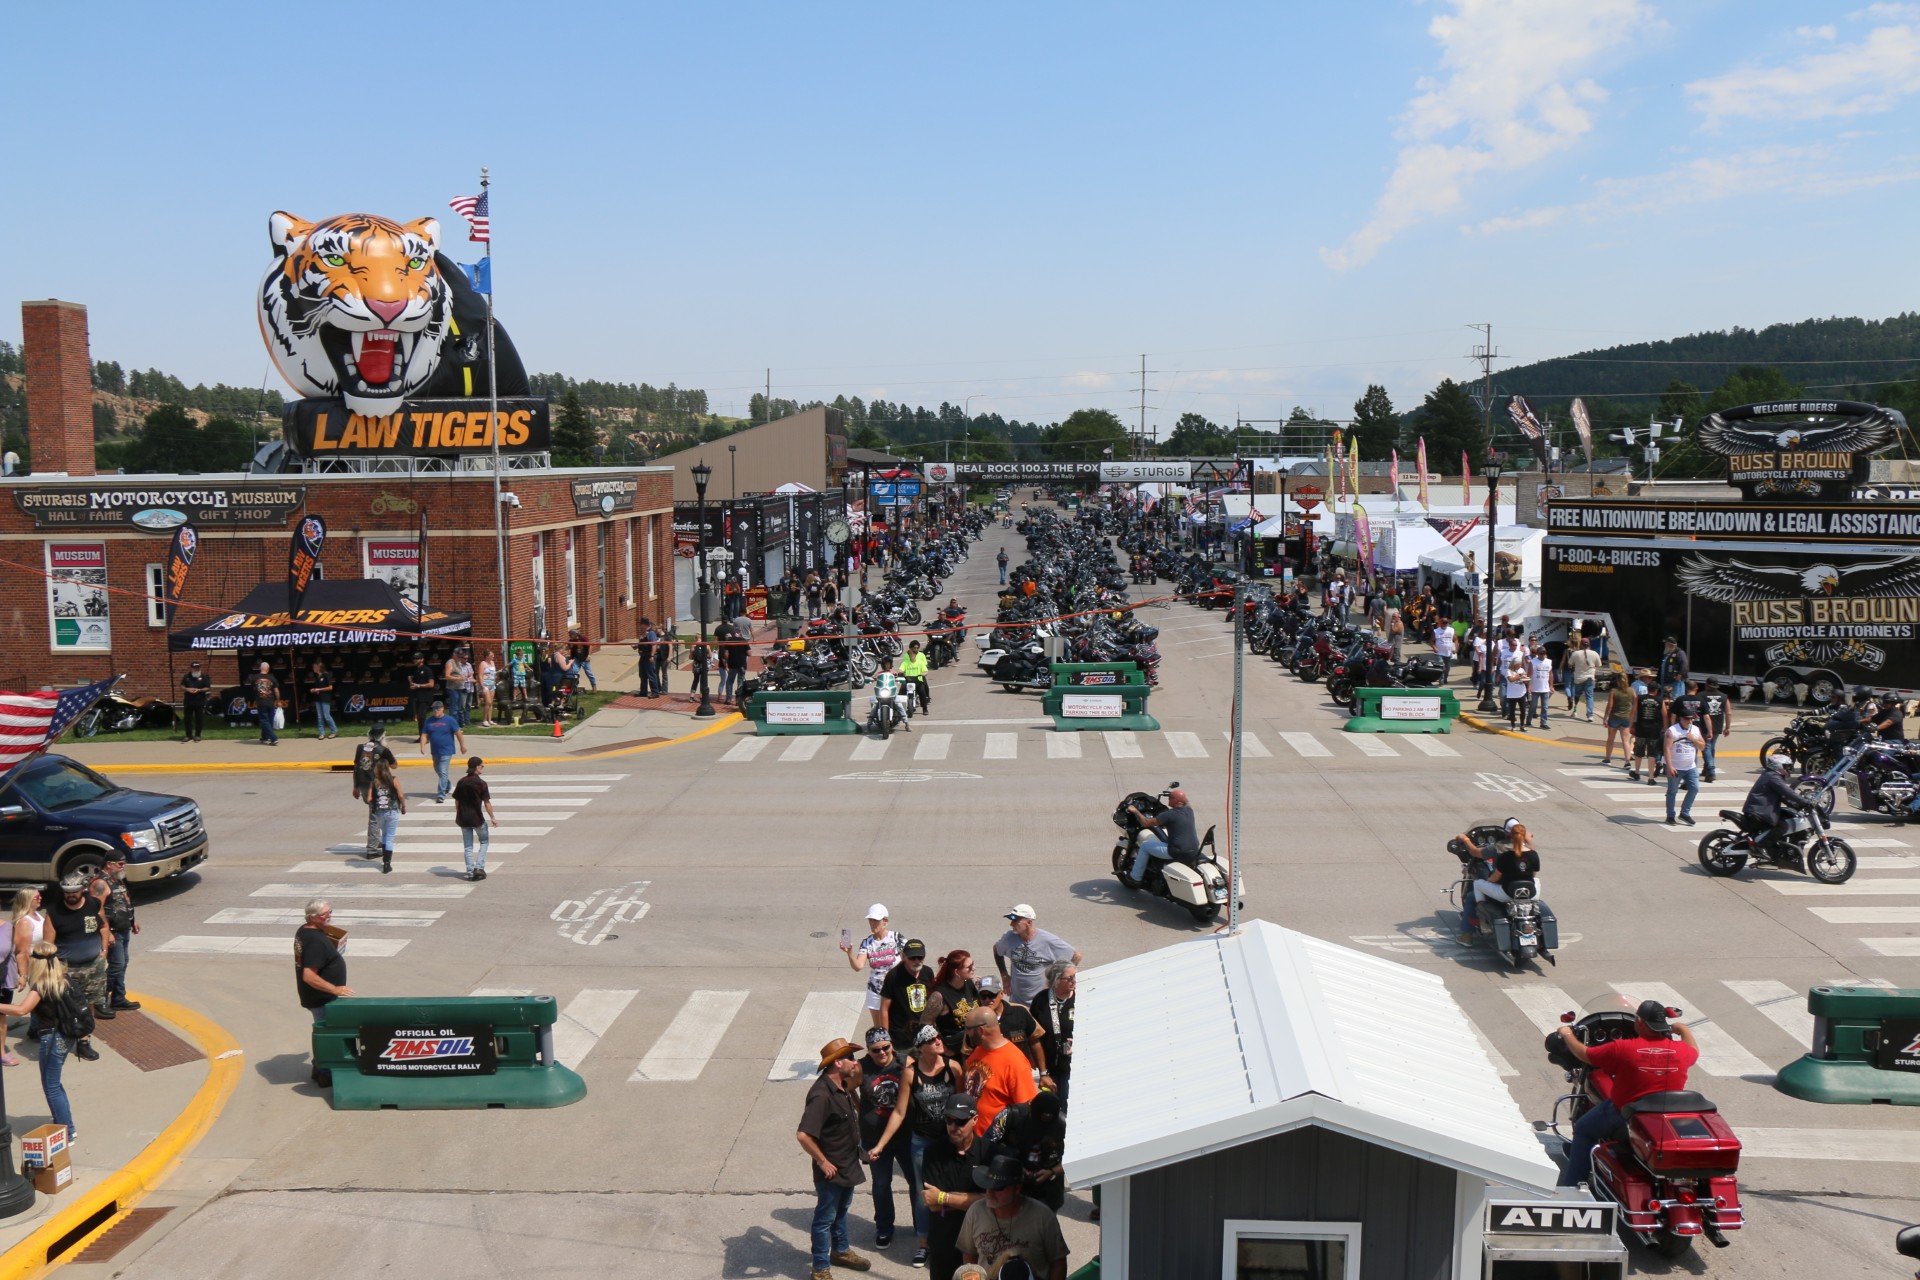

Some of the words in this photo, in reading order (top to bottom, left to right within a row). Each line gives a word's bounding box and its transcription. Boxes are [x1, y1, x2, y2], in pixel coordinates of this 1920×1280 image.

[1753, 404, 1798, 415] WELCOME
[1800, 403, 1838, 412] RIDERS!
[313, 411, 404, 450] LAW
[410, 410, 531, 449] TIGERS
[956, 464, 985, 473] REAL
[987, 464, 1018, 473] ROCK
[1021, 464, 1050, 473] 100.3
[1052, 464, 1075, 472] THE
[1076, 464, 1099, 472] FOX
[1729, 454, 1775, 471] RUSS
[1779, 452, 1851, 470] BROWN
[1133, 467, 1185, 477] STURGIS
[1733, 471, 1789, 481] MOTORCYCLE
[1790, 470, 1846, 479] ATTORNEYS
[23, 494, 87, 508] STURGIS
[90, 491, 228, 509] MOTORCYCLE
[231, 491, 298, 505] MUSEUM
[48, 511, 77, 521] HALL
[89, 511, 123, 521] FAME
[198, 510, 229, 521] GIFT
[234, 509, 272, 521] SHOP
[1550, 508, 1580, 527] FREE
[1582, 509, 1666, 530] NATIONWIDE
[1668, 511, 1761, 532] BREAKDOWN
[1763, 512, 1776, 532] &
[1778, 512, 1826, 533] LEGAL
[55, 551, 101, 561] MUSEUM
[373, 549, 420, 559] MUSEUM
[1557, 548, 1661, 567] 1-800-4-BIKERS
[168, 555, 181, 583] LAW
[291, 549, 306, 577] LAW
[1558, 564, 1614, 573] RUSSBROWN.COM
[172, 562, 189, 599] TIGERS
[295, 555, 314, 593] TIGERS
[240, 610, 305, 629] LAW
[305, 608, 391, 625] TIGERS
[1735, 600, 1804, 625] RUSS
[1812, 598, 1919, 624] BROWN
[191, 634, 254, 649] AMERICA'S
[256, 631, 337, 647] MOTORCYCLE
[338, 629, 397, 644] LAWYERS
[1740, 625, 1825, 639] MOTORCYCLE
[1829, 625, 1911, 638] ATTORNEYS
[1081, 676, 1115, 685] AMSOIL
[366, 697, 383, 706] LAW
[384, 696, 409, 705] TIGERS
[395, 1029, 436, 1037] OFFICIAL
[382, 1038, 473, 1060] AMSOIL
[49, 1131, 65, 1146] FREE
[22, 1142, 43, 1151] FREE
[1500, 1207, 1602, 1229] ATM
